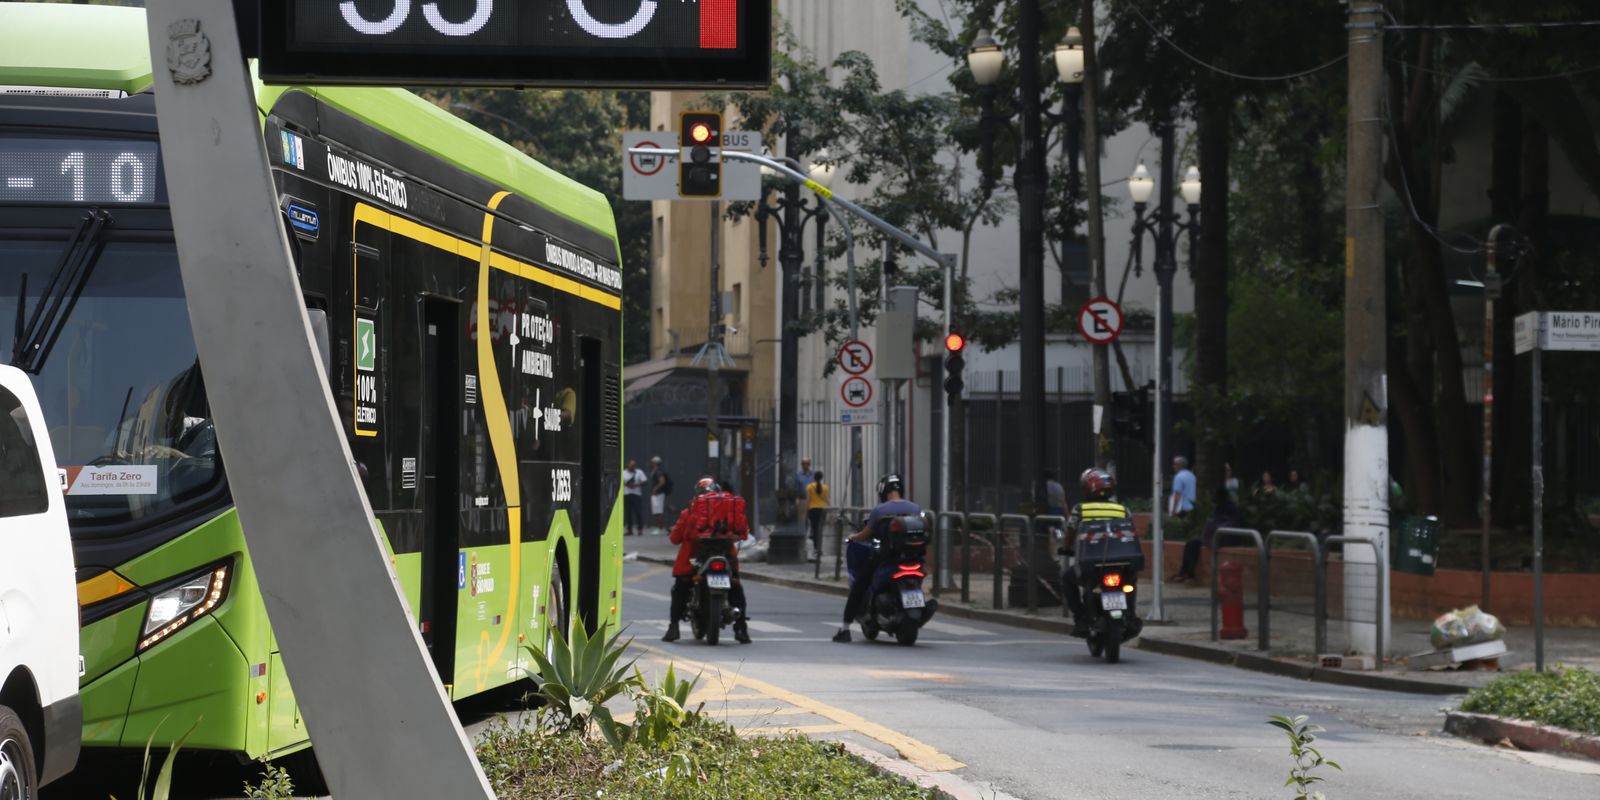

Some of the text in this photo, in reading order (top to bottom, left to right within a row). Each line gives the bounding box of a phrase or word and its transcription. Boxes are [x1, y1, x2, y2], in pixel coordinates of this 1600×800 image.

[723, 134, 749, 146] BUS
[327, 145, 357, 190] ÔNIBUS
[356, 161, 375, 196] 100%
[374, 168, 407, 209] ELÉTRICO
[521, 313, 554, 348] PROTEÇÃO
[1553, 314, 1581, 329] Mário
[521, 350, 554, 379] AMBIENTAL
[357, 375, 376, 403] 100%
[357, 402, 376, 424] ELÉTRICO
[544, 402, 562, 432] SAÚDE
[90, 472, 142, 481] Tarifa Zero
